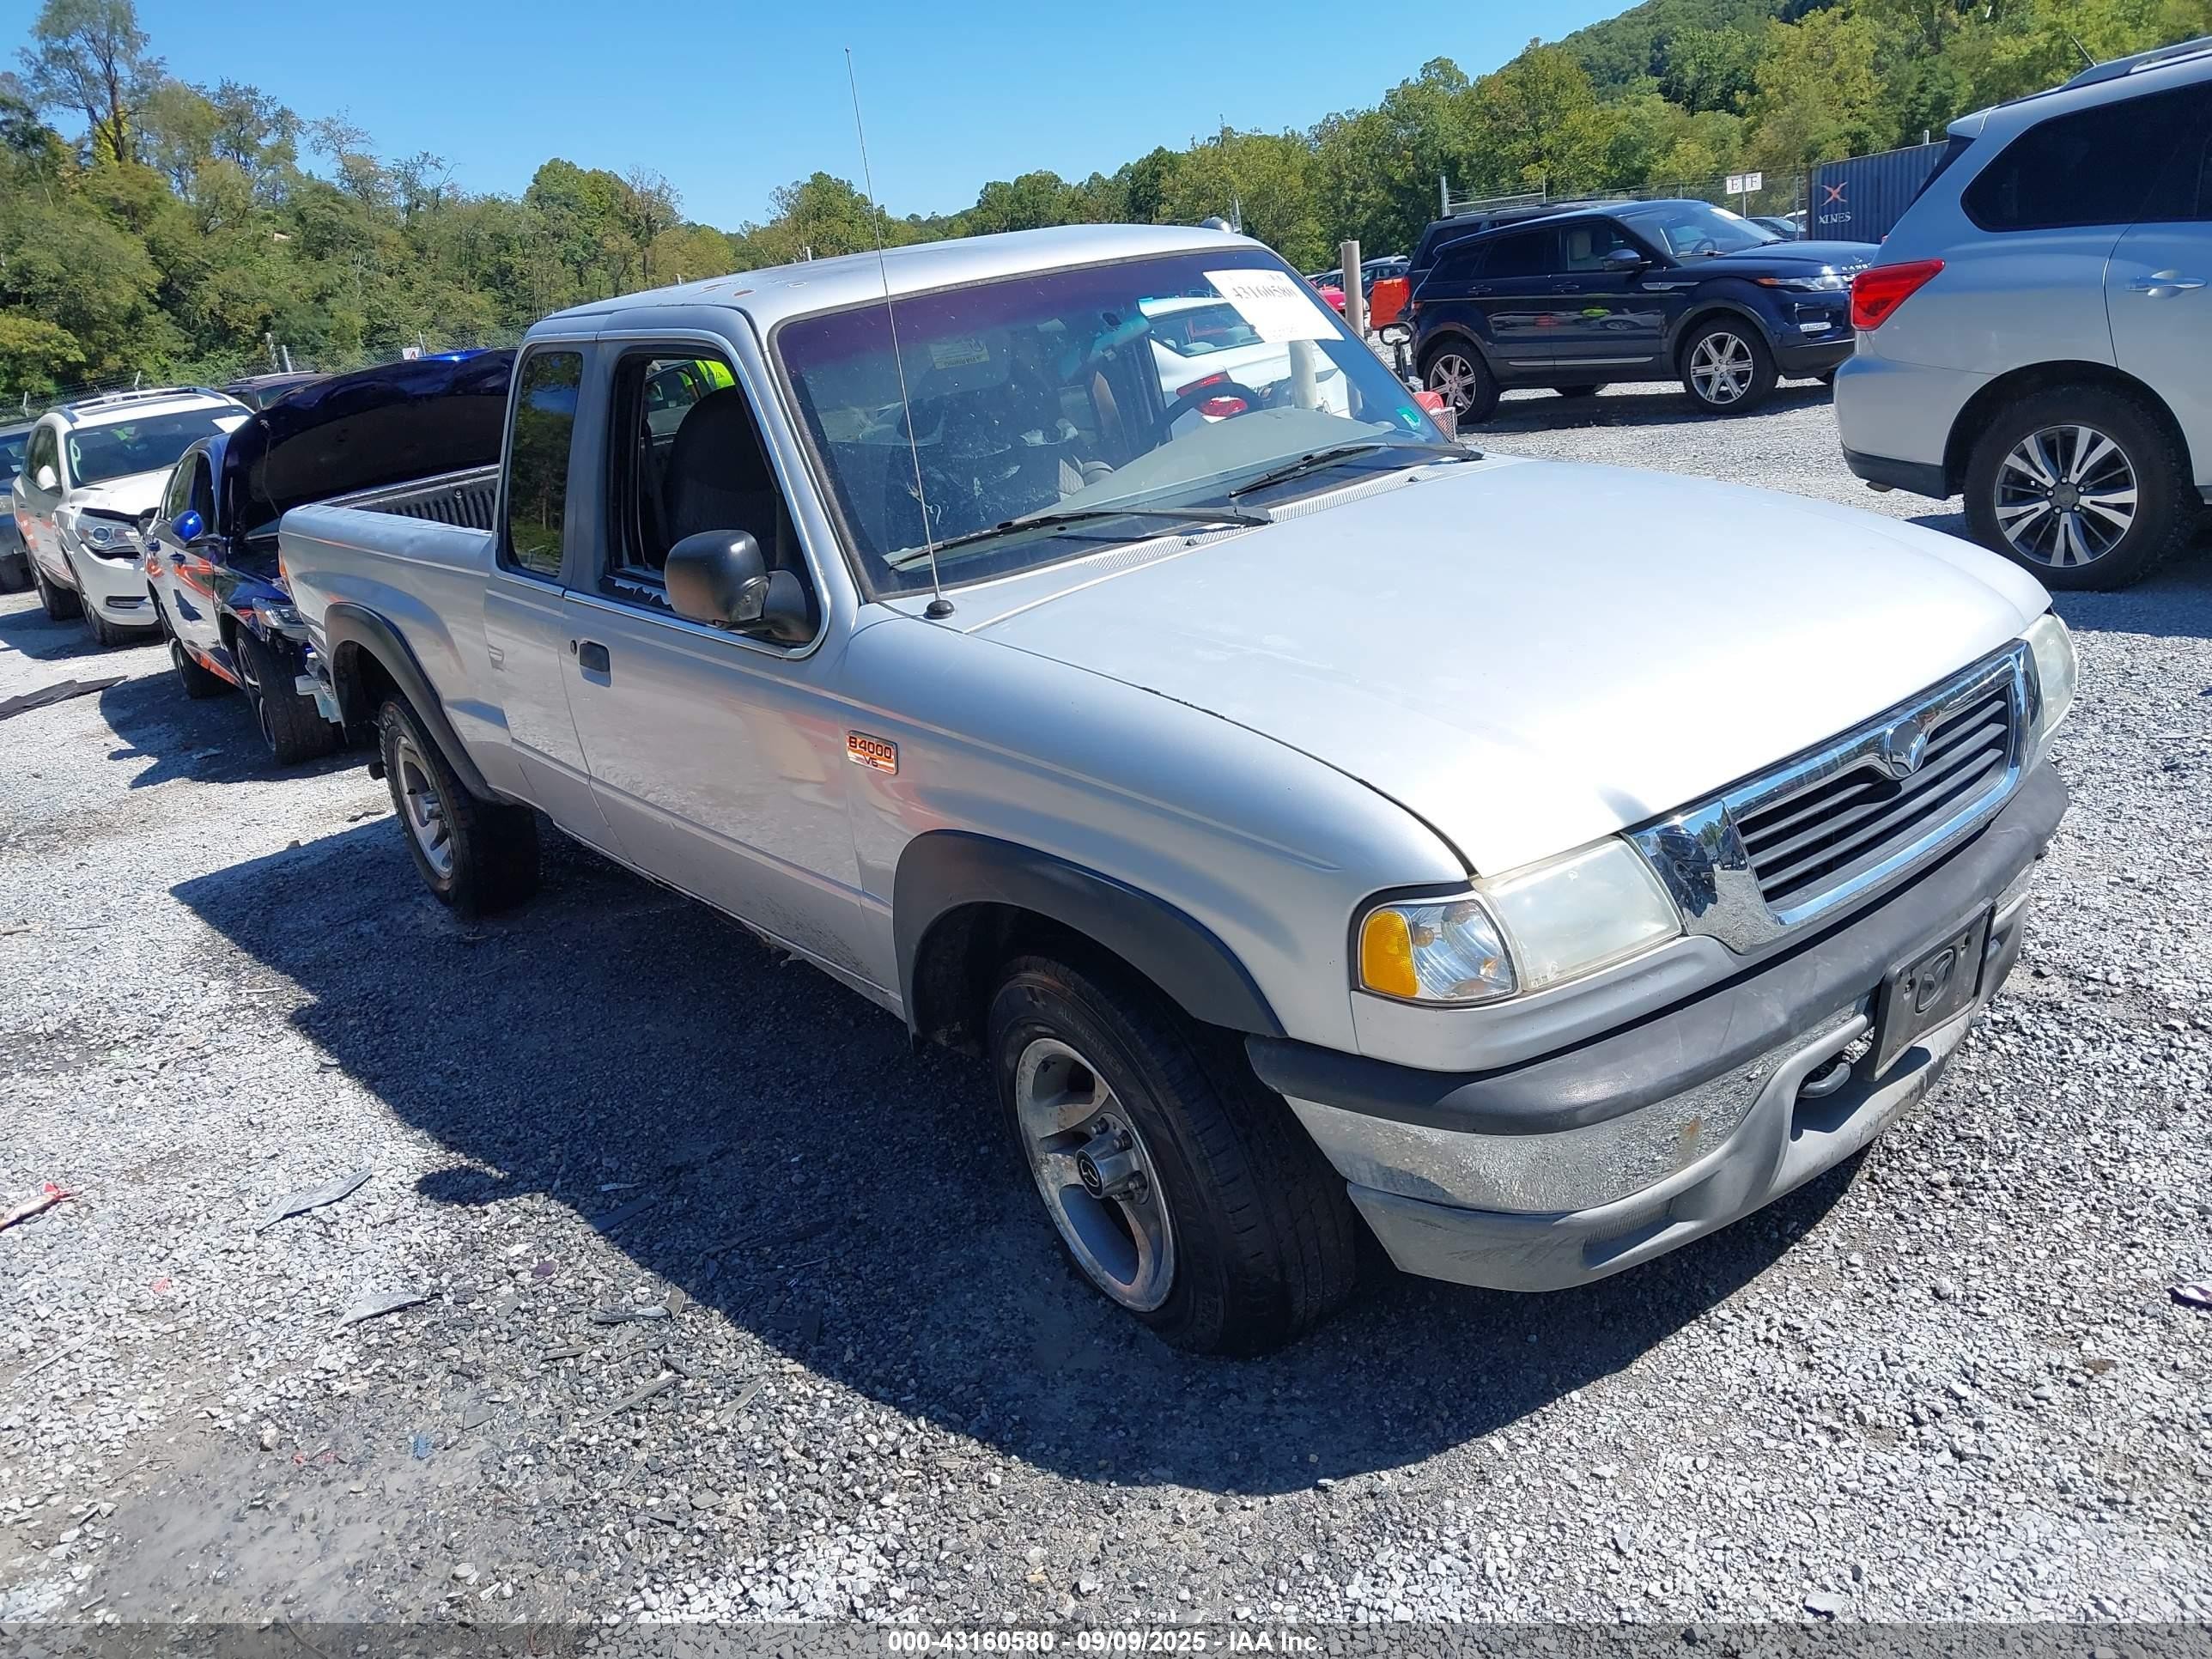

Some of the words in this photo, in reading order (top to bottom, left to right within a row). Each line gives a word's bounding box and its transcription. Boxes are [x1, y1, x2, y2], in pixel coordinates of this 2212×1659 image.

[1730, 178, 1739, 191] E
[1748, 175, 1758, 188] F
[1819, 211, 1851, 225] XINES
[848, 735, 892, 759] B4000
[864, 755, 878, 767] V6
